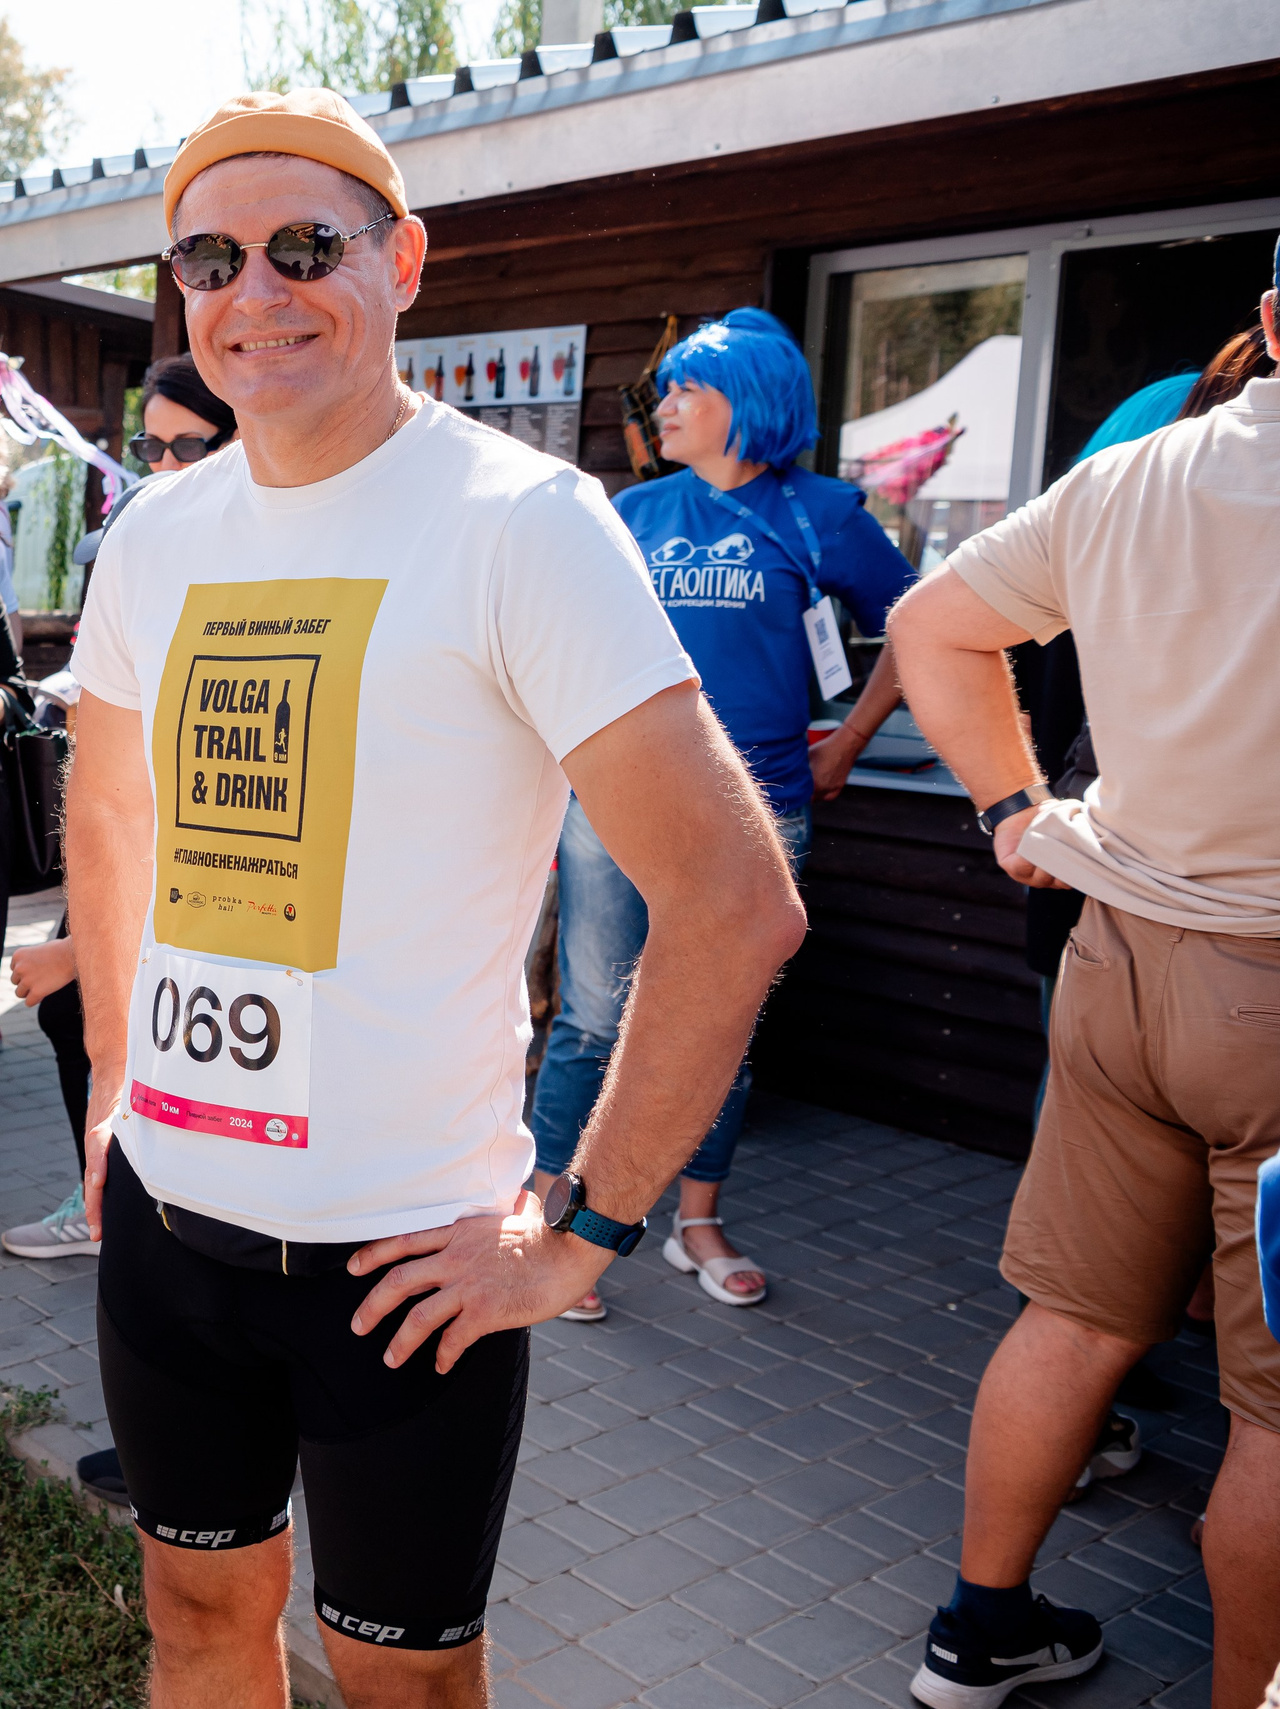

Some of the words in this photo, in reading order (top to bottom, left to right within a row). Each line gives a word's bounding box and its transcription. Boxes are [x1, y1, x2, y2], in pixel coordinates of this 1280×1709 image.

[650, 566, 765, 603] ЕГАОПТИКА
[667, 599, 715, 608] КОРРЕКЦИИ
[715, 600, 746, 610] ЗРЕНИЯ
[203, 619, 246, 636] ПЕРВЫЙ
[247, 617, 293, 636] ВИННЫЙ
[294, 619, 331, 634] ЗАБЕГ
[199, 678, 270, 714] VOLGA
[193, 724, 266, 763] TRAIL
[192, 771, 208, 804] &
[215, 772, 288, 813] DRINK
[173, 848, 298, 880] #ГЛАВНОЕНЕНАЖРАТЬСЯ
[212, 895, 242, 905] probka
[218, 904, 234, 912] hall
[152, 976, 281, 1071] 069
[161, 1101, 169, 1112] 10
[229, 1116, 253, 1129] 2024
[179, 1529, 236, 1548] cep
[341, 1614, 405, 1643] cep
